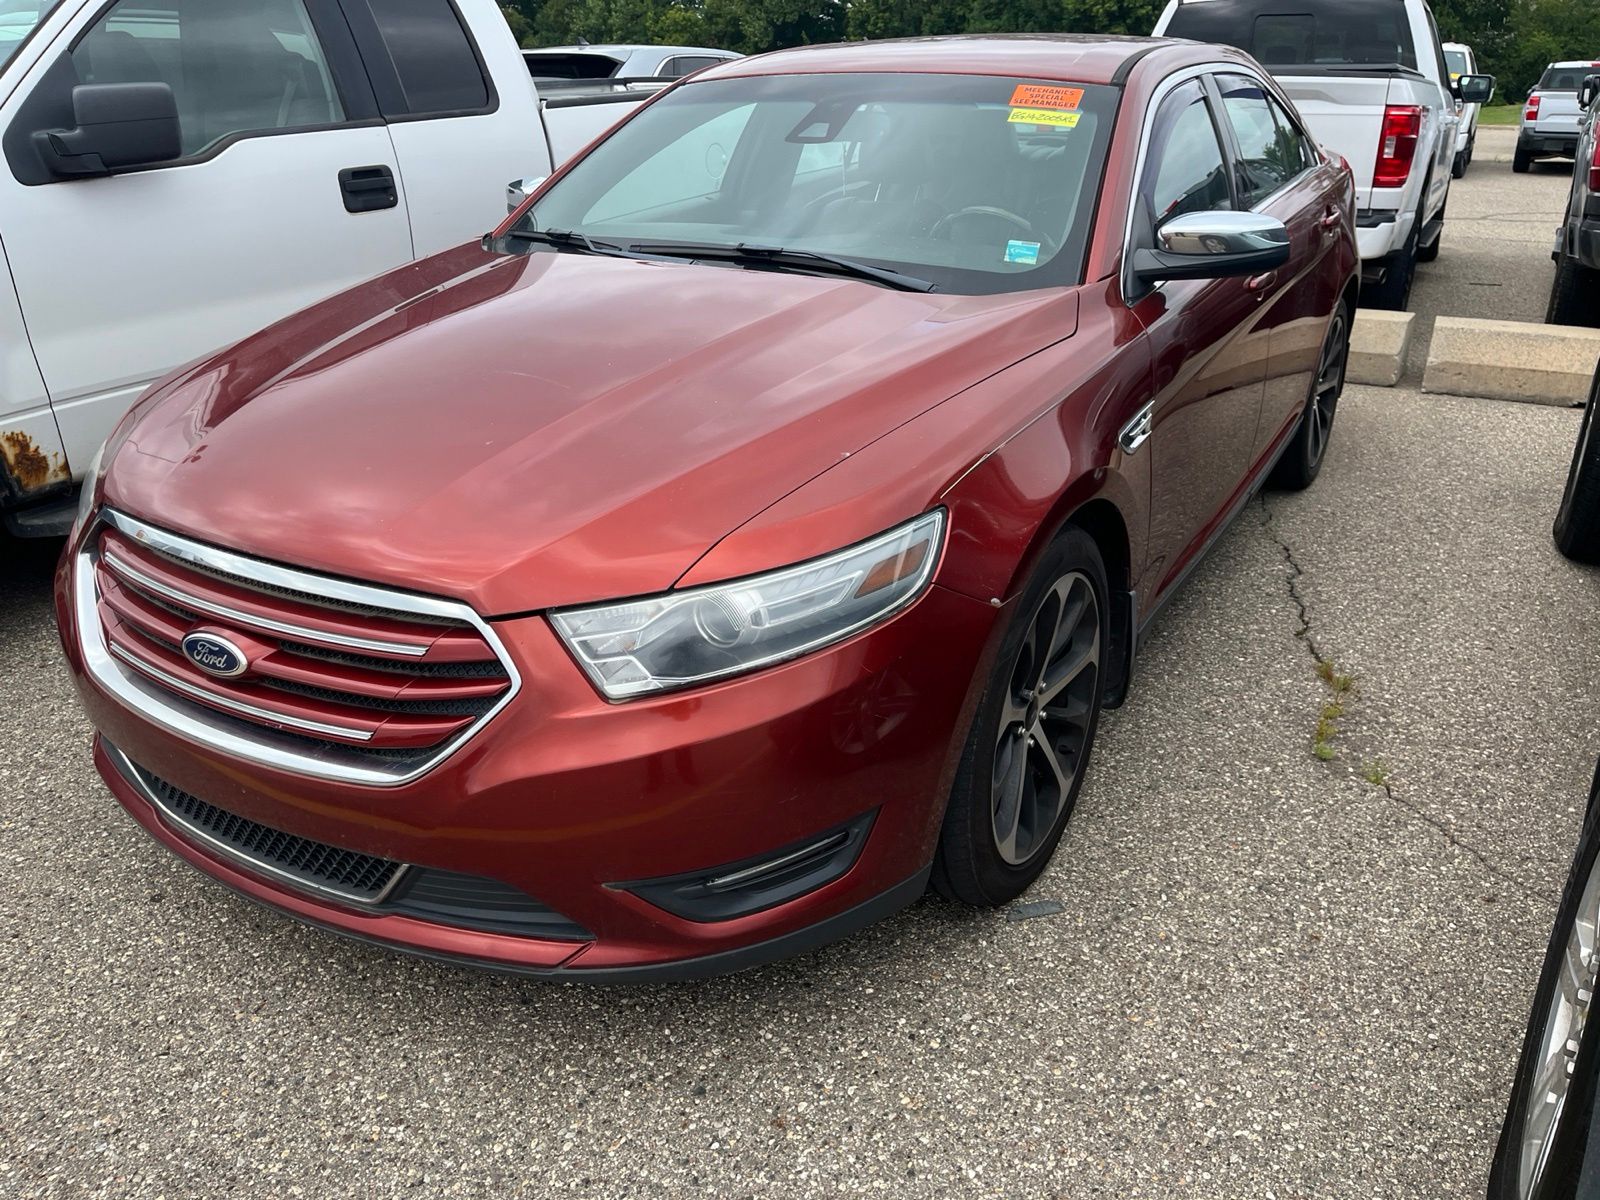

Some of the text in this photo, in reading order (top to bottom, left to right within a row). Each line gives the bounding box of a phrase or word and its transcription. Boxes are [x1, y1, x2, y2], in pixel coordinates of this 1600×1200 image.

[1024, 87, 1074, 96] MECHANICS
[1029, 93, 1064, 101] SPECIAL
[1031, 100, 1076, 108] MANAGER
[193, 641, 227, 668] Ford
